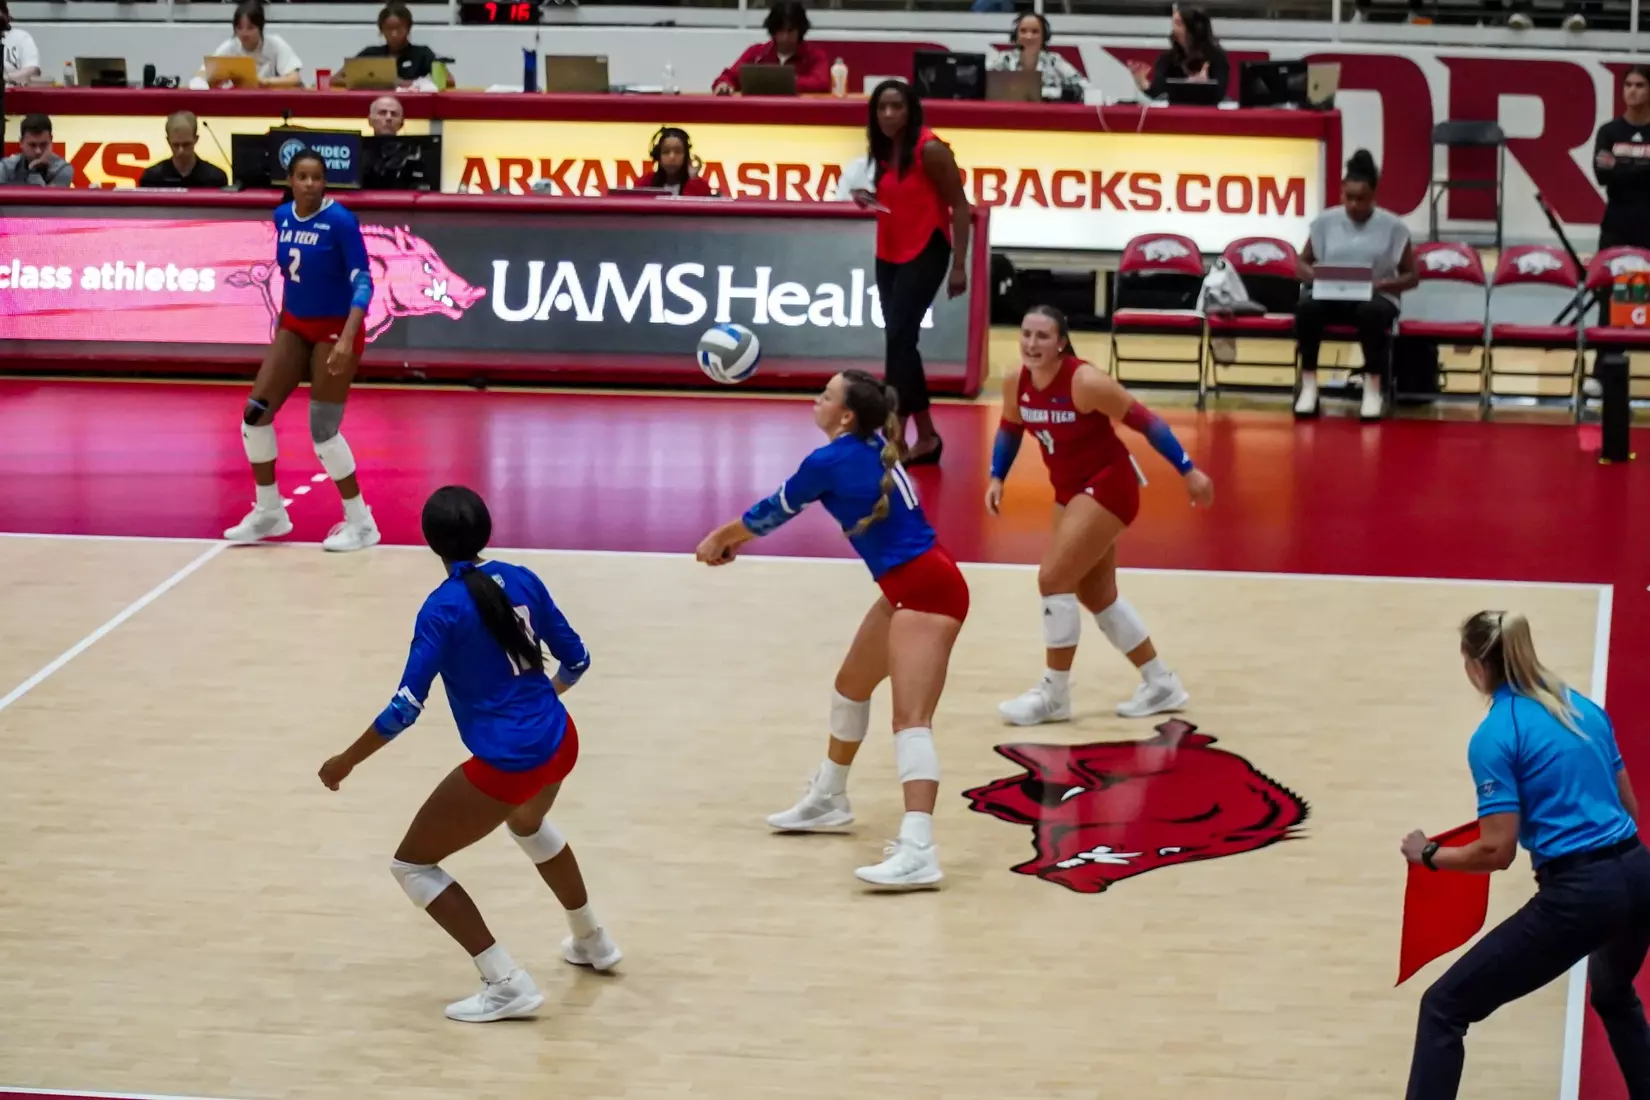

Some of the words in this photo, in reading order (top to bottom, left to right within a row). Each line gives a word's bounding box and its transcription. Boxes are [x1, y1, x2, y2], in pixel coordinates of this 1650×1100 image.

[325, 158, 351, 170] VIEW
[279, 229, 292, 243] LA
[294, 230, 319, 246] TECH
[0, 259, 72, 290] class
[80, 260, 216, 292] athletes
[288, 247, 302, 283] 2
[491, 259, 708, 324] UAMS
[713, 264, 934, 329] Healt
